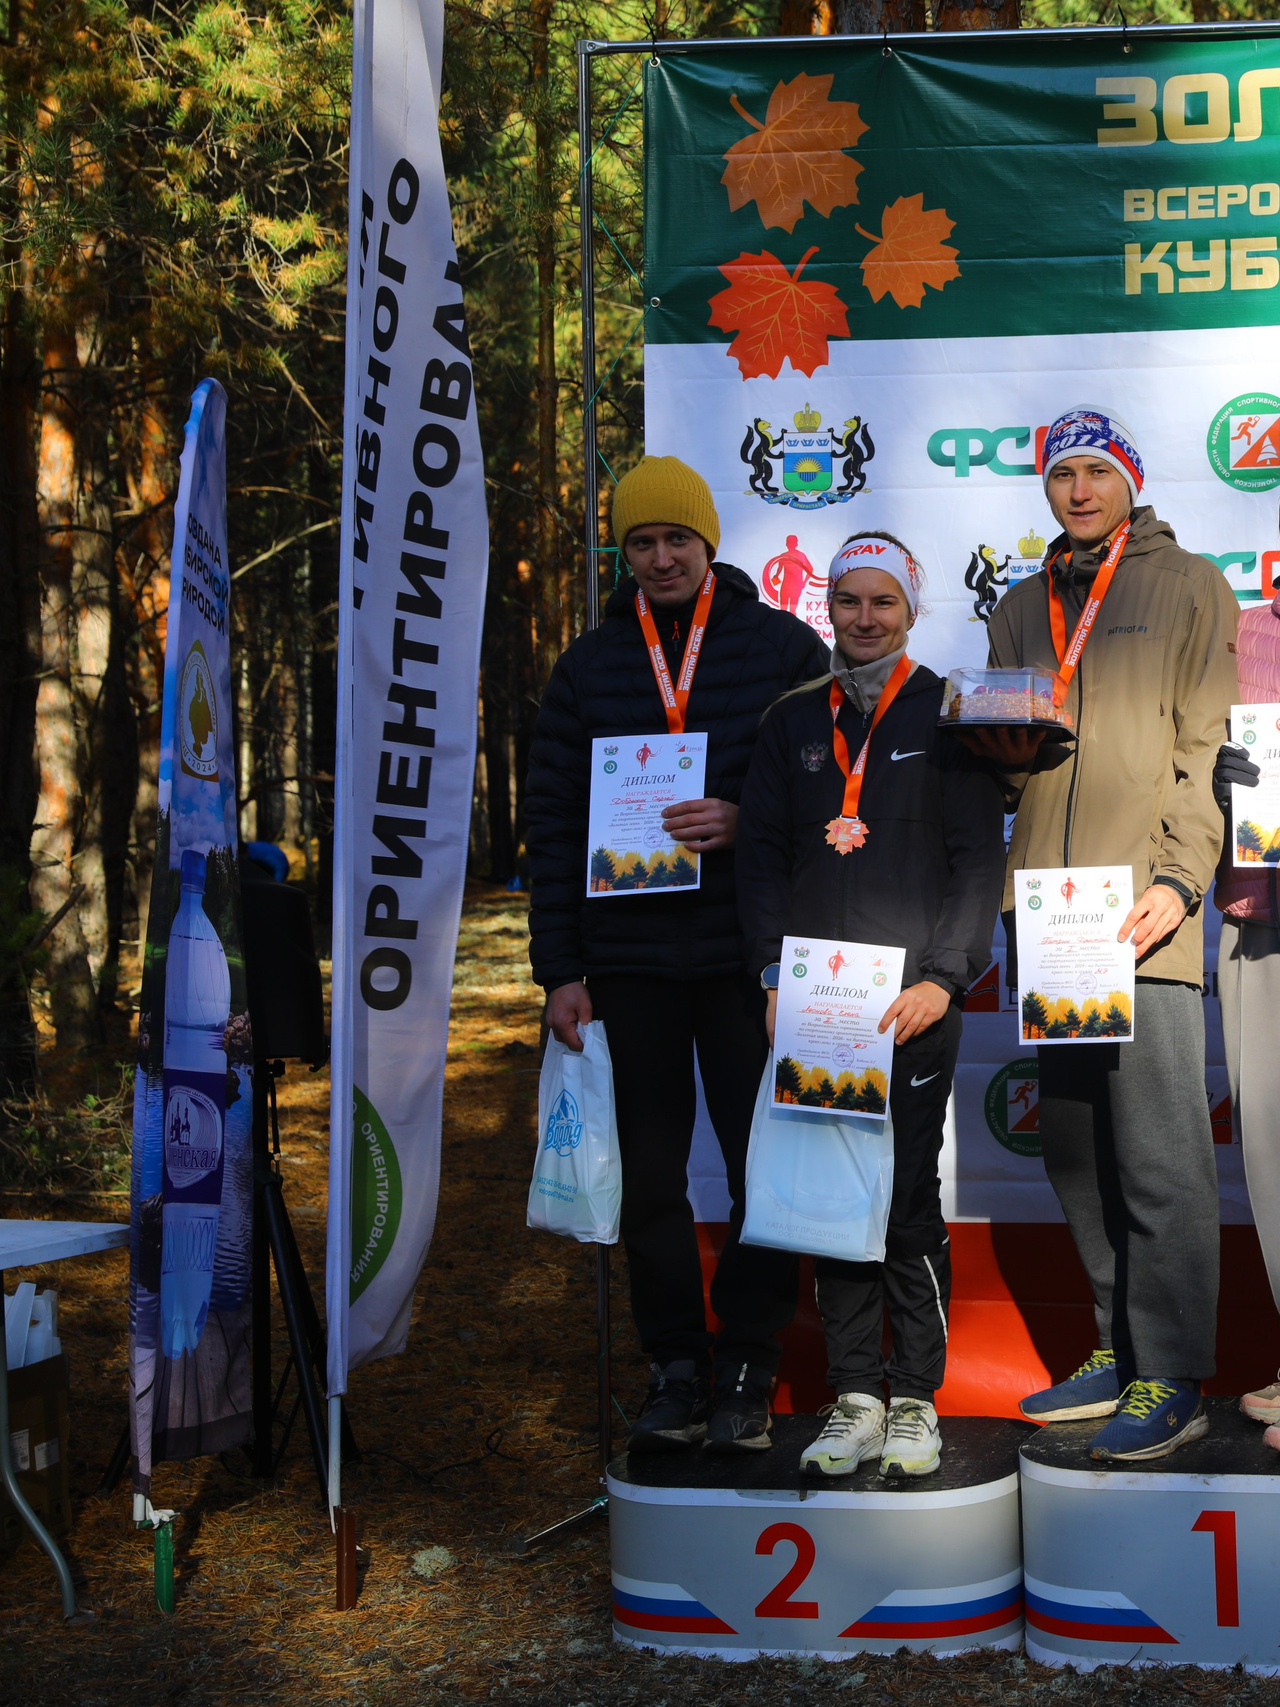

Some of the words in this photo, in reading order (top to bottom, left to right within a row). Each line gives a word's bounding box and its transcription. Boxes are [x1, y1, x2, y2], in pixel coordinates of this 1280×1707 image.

[1212, 407, 1234, 445] ФЕДЕРАЦИЯ
[1212, 449, 1230, 478] ОБЛАСТИ
[1234, 477, 1276, 488] ТЮМЕНСКОЙ
[187, 512, 223, 569] ОЗДАНА
[1105, 535, 1125, 567] ТЮМЕНЬ
[182, 576, 226, 636] РИРОДОЙ
[806, 601, 830, 612] КУБ
[1068, 628, 1087, 667] ЗОЛОТАЯ
[1084, 600, 1100, 627] ОСЕНЬ
[1107, 626, 1137, 637] PATRIOT
[655, 644, 666, 670] ОСЕНЬ
[682, 655, 696, 691] ЗОЛОТАЯ
[692, 626, 704, 653] ОСЕНЬ
[662, 671, 676, 707] ЗОЛОТАЯ
[621, 774, 676, 787] ДИПЛОМ
[626, 789, 672, 797] НАГРАЖДАЕТСЯ
[850, 823, 861, 834] 2
[1048, 913, 1104, 926] ДИПЛОМ
[810, 984, 869, 999] ДИПЛОМ
[814, 1001, 863, 1010] НАГРАЖДАЕТСЯ
[989, 1070, 1011, 1108] ФЕДЕРАЦИЯ
[990, 1112, 1009, 1141] ОБЛАСТИ
[351, 1122, 390, 1283] ОРИЕНТИРОВАНИЯ
[766, 1222, 799, 1233] КАТАЛОГ
[801, 1226, 850, 1241] ПРОДУКЦИИ
[754, 1522, 820, 1620] 2
[1190, 1509, 1240, 1627] 1
